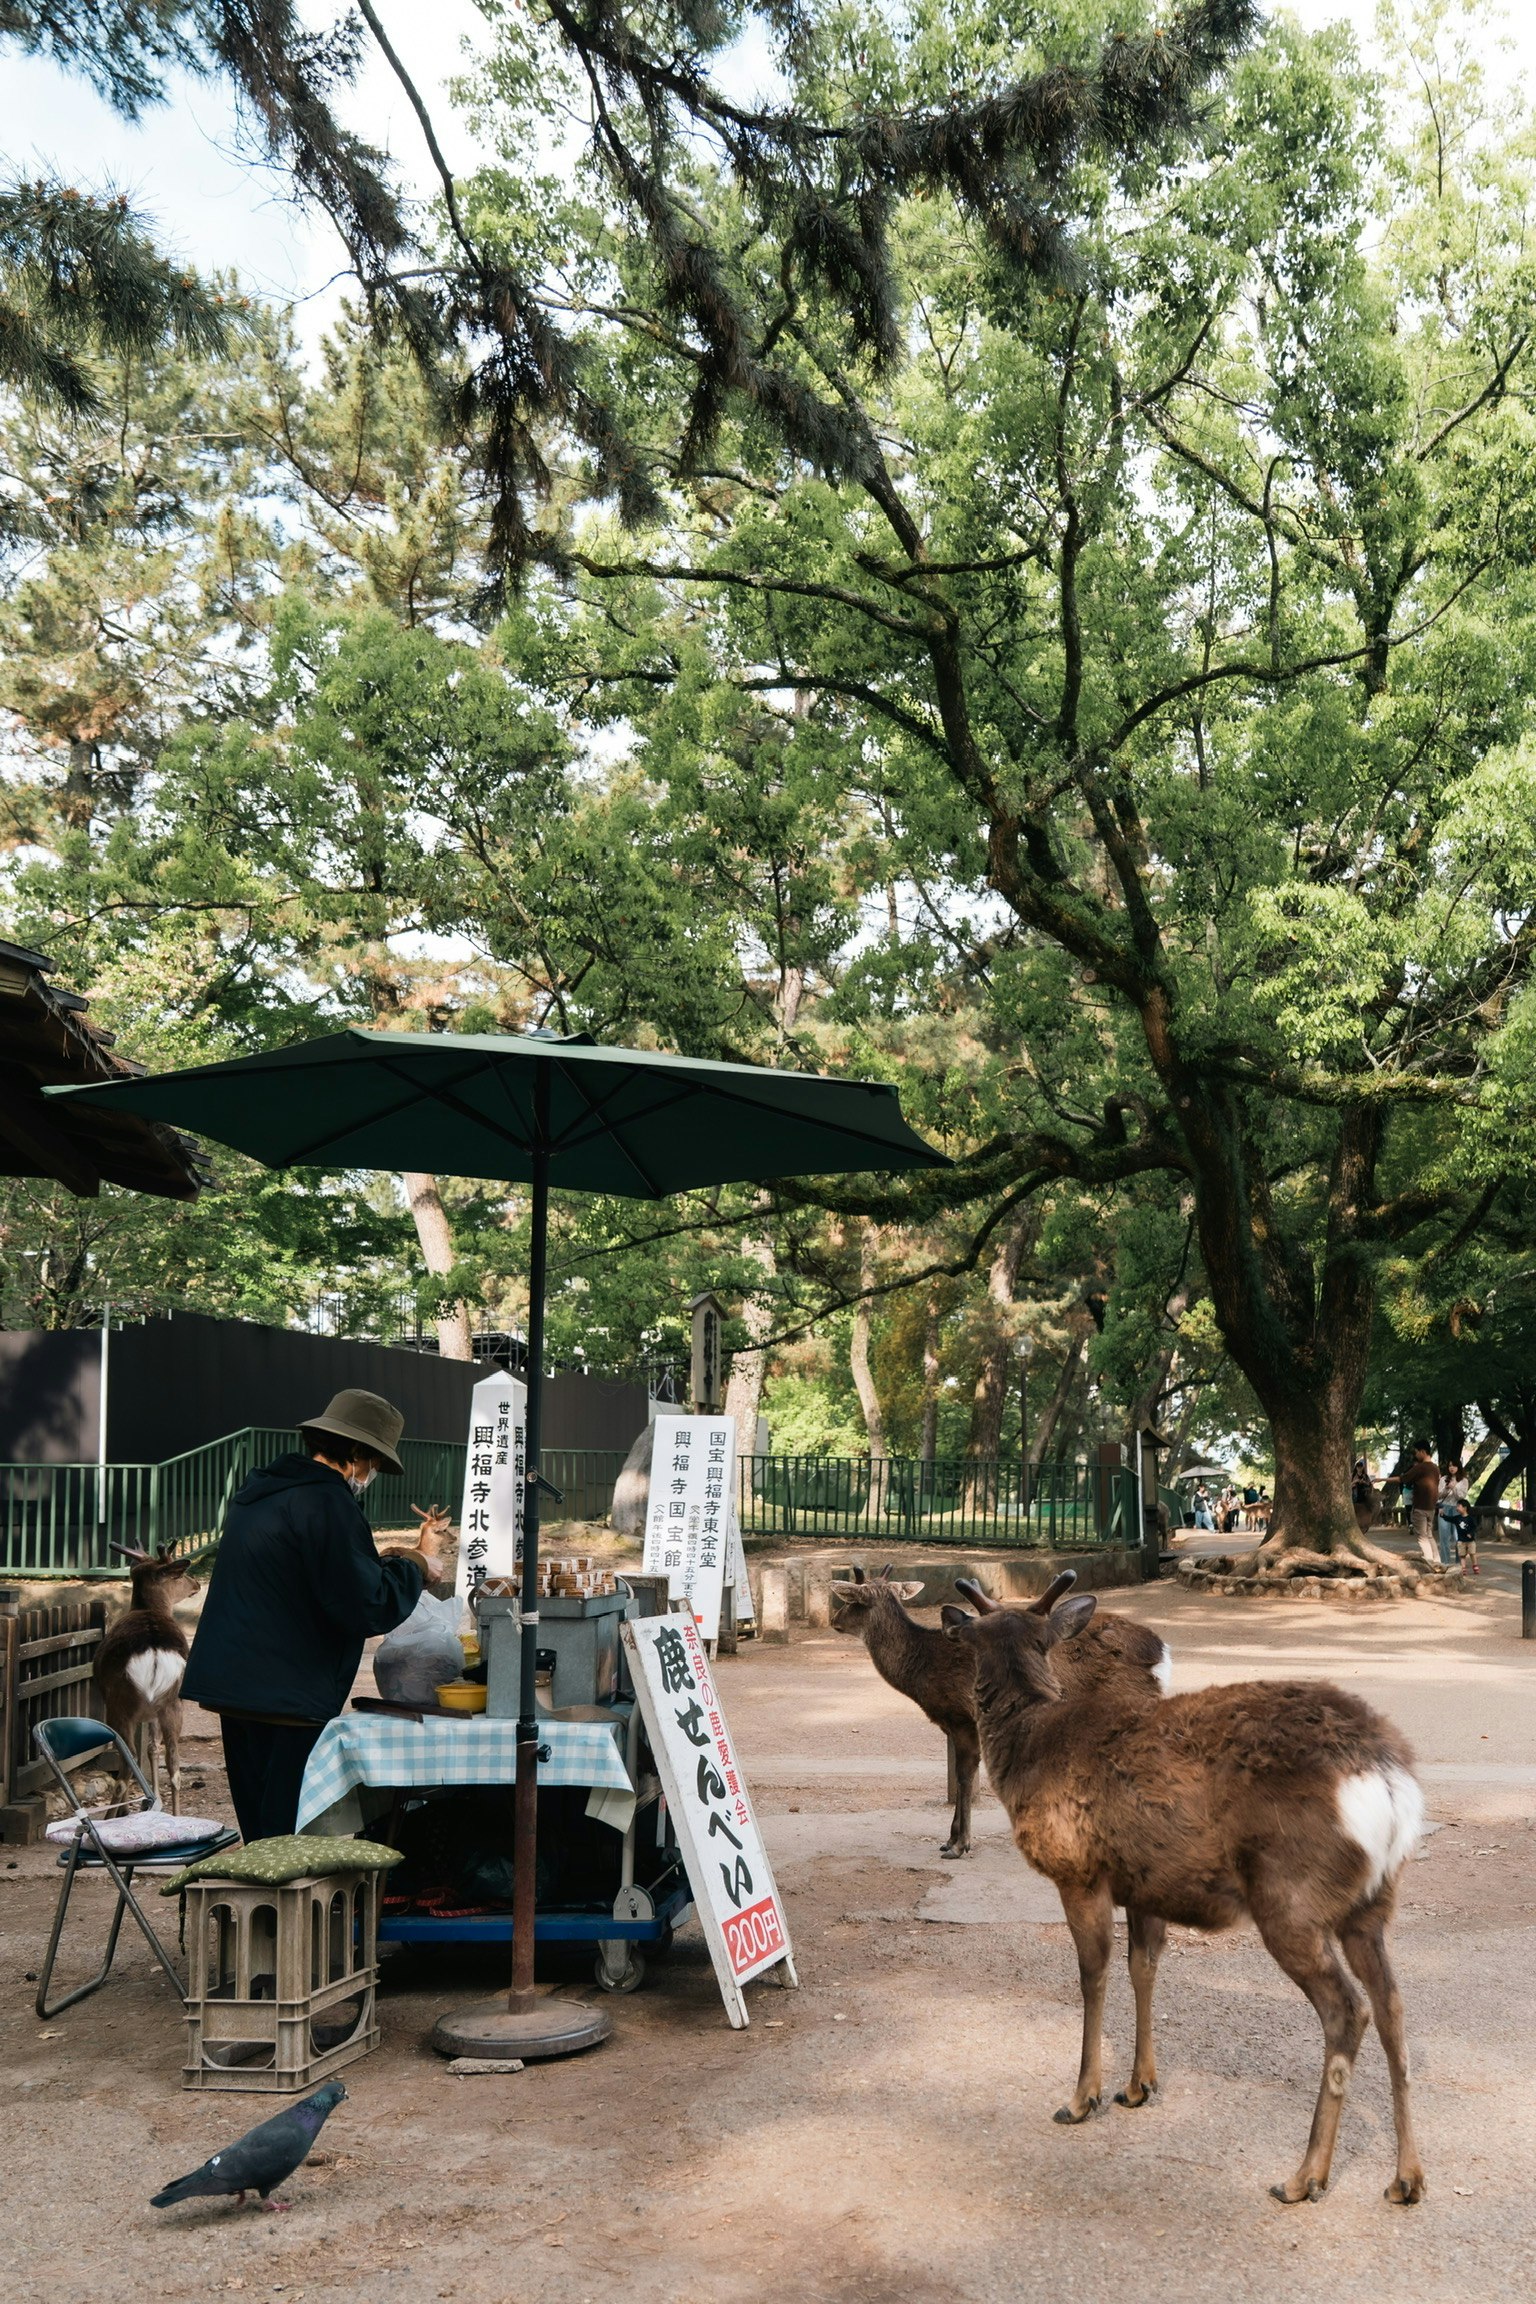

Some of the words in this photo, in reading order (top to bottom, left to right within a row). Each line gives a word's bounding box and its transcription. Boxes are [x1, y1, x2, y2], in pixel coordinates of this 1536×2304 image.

[495, 1401, 511, 1465] 世界遺産
[664, 1430, 692, 1568] 興福寺国宝館
[699, 1431, 727, 1569] 国宝興福寺東金堂
[652, 1625, 754, 1910] 鹿せんべい
[683, 1624, 750, 1827] 奈良の鹿愛護会
[727, 1911, 782, 1969] 200円
